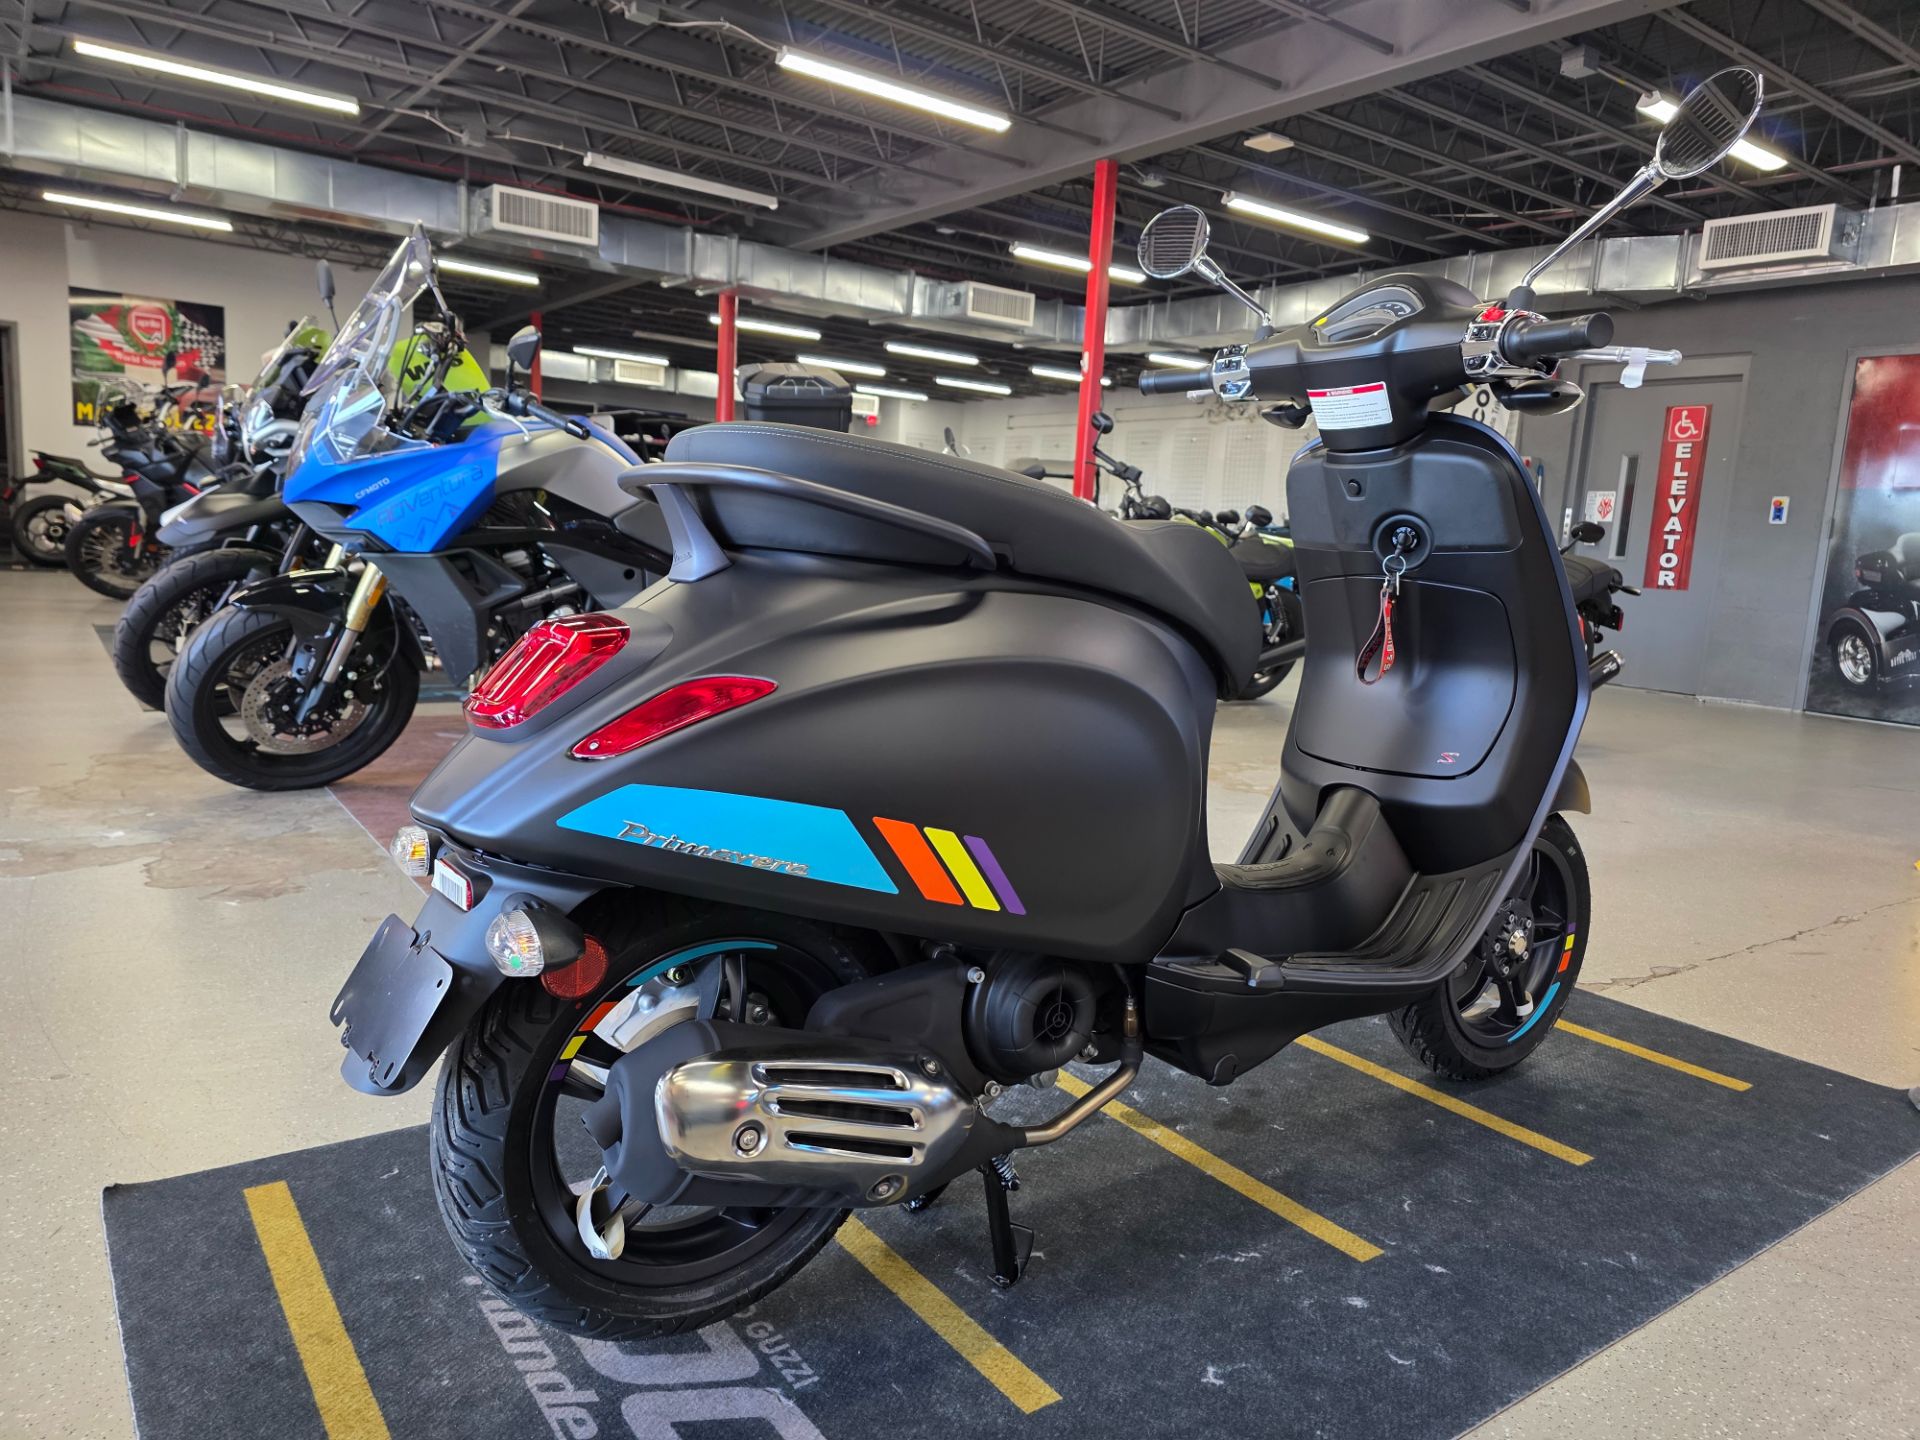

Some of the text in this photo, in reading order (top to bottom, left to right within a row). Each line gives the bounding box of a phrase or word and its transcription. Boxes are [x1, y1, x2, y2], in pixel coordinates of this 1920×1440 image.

[355, 477, 390, 500] CFMOTO
[1657, 443, 1693, 587] ELEVATOR
[617, 820, 809, 877] Primavera
[746, 1321, 820, 1390] GUZZI
